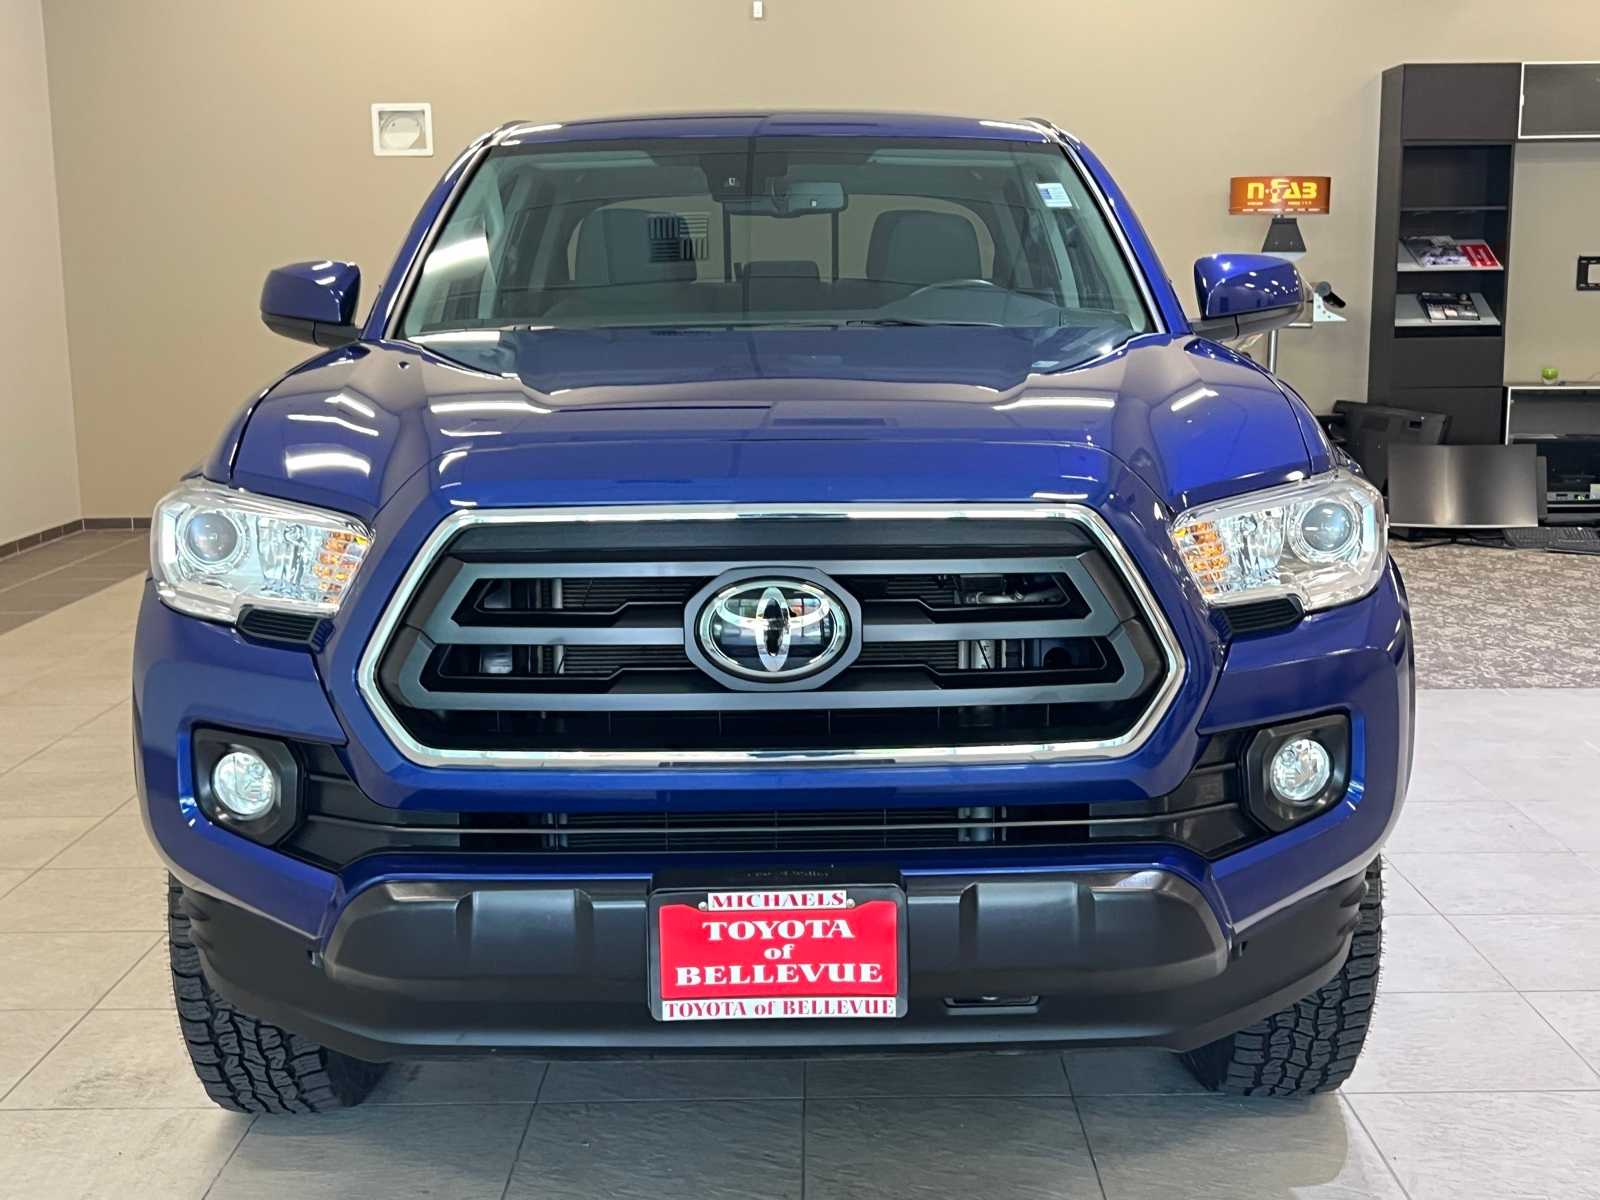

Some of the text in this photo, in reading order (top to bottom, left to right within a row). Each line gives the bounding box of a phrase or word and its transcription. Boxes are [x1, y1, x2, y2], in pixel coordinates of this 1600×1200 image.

[712, 892, 845, 908] MICHAELS
[702, 919, 856, 941] TOYOTA
[763, 943, 795, 960] of
[675, 963, 883, 986] BELLEVUE
[665, 999, 895, 1018] TOYOTA of BELLEVUE
